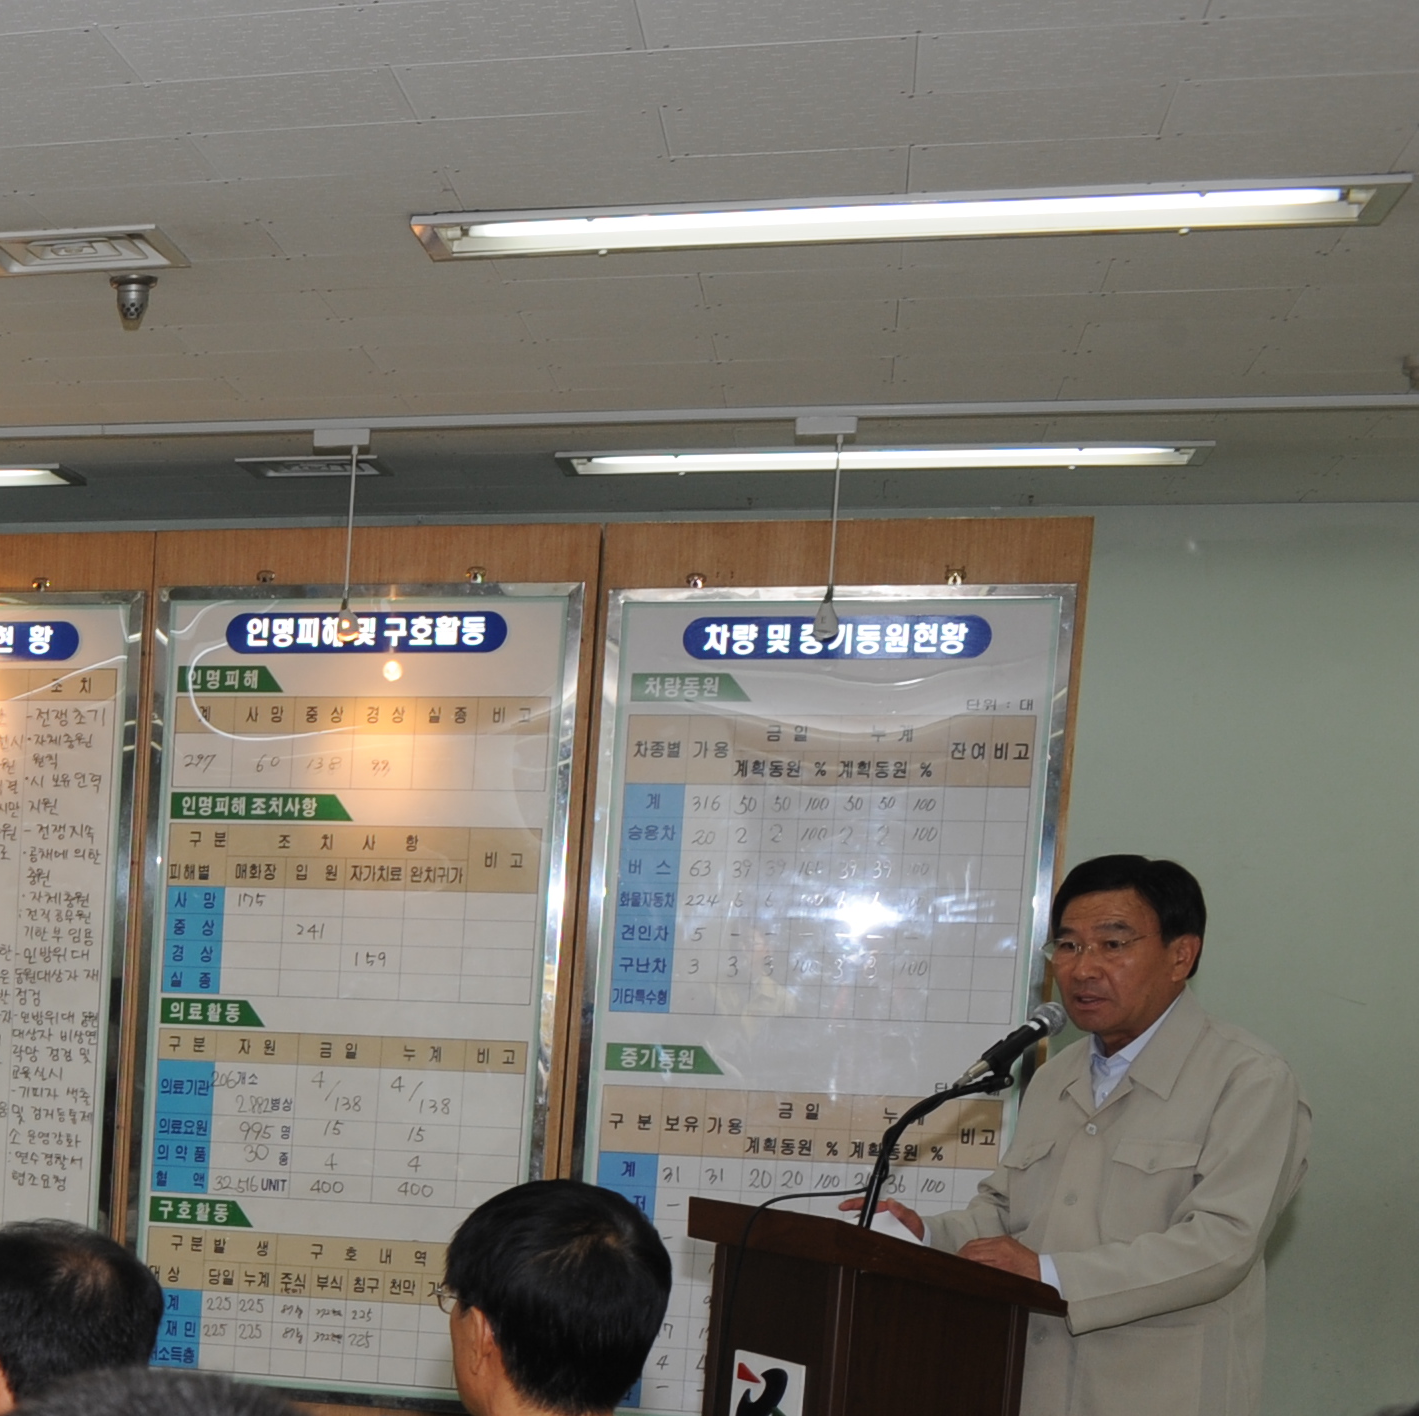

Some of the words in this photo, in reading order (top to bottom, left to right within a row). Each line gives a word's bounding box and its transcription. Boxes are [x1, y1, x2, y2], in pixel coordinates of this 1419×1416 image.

[383, 614, 485, 647] 구호활동
[703, 623, 758, 655] 차량
[767, 623, 791, 653] 및
[191, 669, 258, 690] 인명피해
[644, 677, 720, 698] 차량동원
[634, 741, 681, 759] 차종별
[734, 760, 765, 778] 계획
[768, 760, 801, 777] 동원
[814, 761, 827, 777] %
[837, 760, 871, 778] 계획
[874, 760, 908, 778] 동원
[920, 761, 933, 778] %
[181, 796, 246, 816] 인명피해
[250, 797, 318, 817] 조치사항
[627, 825, 676, 842] 승용차
[170, 864, 210, 881] 피해별
[235, 864, 277, 881] 매화장
[350, 865, 402, 883] 자가치료
[410, 866, 463, 884] 완치귀가
[619, 892, 675, 908] 화물자동차
[620, 923, 669, 942] 견인차
[618, 956, 667, 974] 구난차
[612, 988, 668, 1006] 기타특수형
[169, 1003, 240, 1023] 의료활동
[620, 1048, 695, 1069] 중기동원
[160, 1078, 210, 1096] 의료기관
[157, 1118, 208, 1138] 의료요원
[745, 1136, 777, 1154] 계획
[780, 1137, 812, 1156] 동원
[826, 1141, 839, 1156] %
[930, 1145, 944, 1161] %
[621, 1160, 636, 1178] 계
[261, 1178, 288, 1193] UNIT
[157, 1200, 230, 1223] 구호활동
[208, 1268, 236, 1286] 당일
[243, 1270, 271, 1289] 누계
[279, 1272, 307, 1290] 주식
[316, 1274, 344, 1292] 부식
[353, 1276, 381, 1295] 침구
[389, 1277, 417, 1297] 천막
